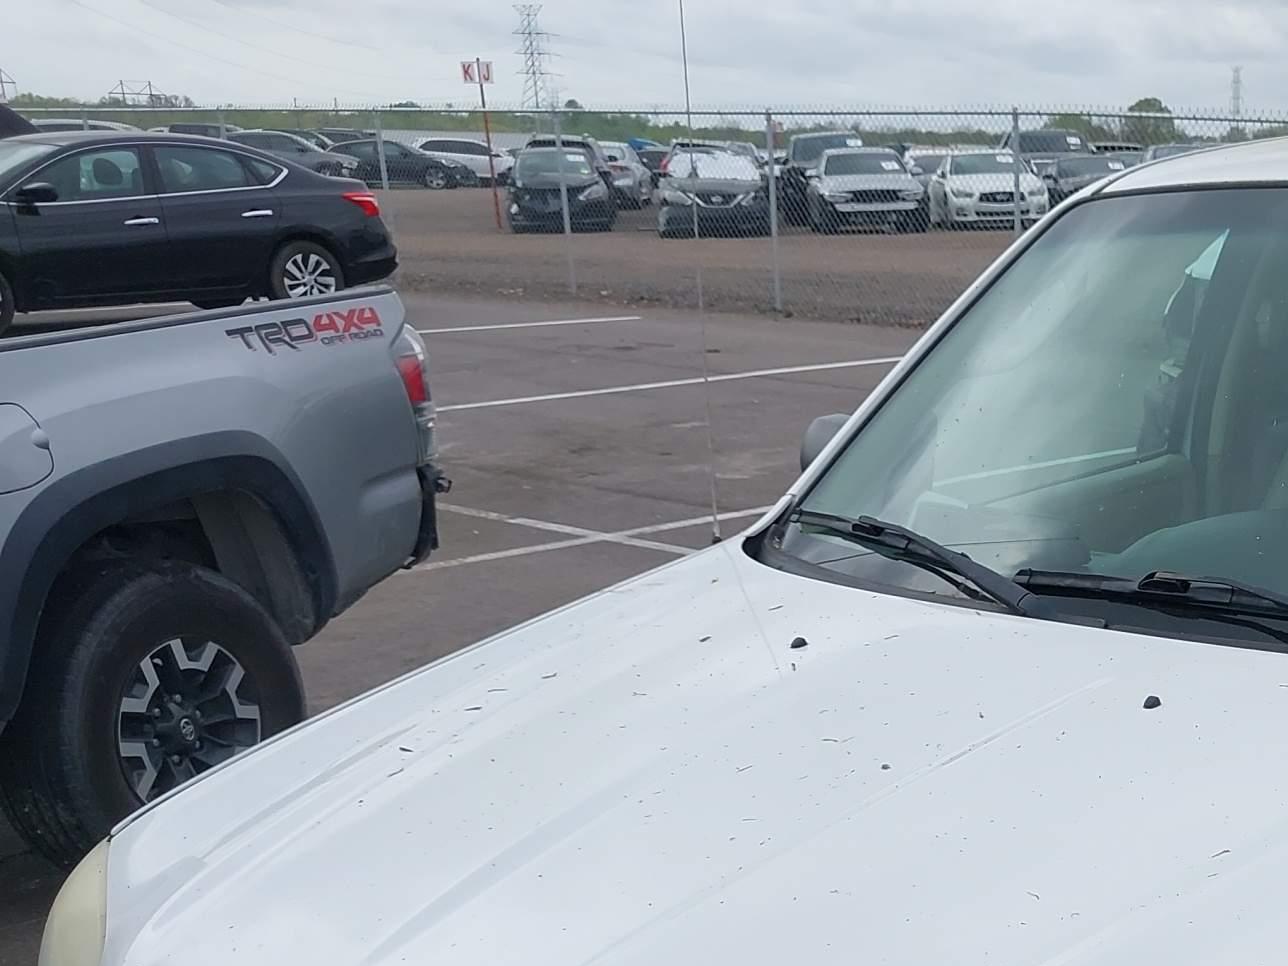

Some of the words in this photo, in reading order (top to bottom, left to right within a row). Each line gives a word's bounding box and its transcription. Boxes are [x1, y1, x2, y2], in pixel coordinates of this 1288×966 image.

[462, 63, 473, 81] K
[482, 63, 490, 81] J
[225, 318, 316, 356] TRD
[320, 334, 347, 346] OFF
[349, 328, 385, 342] ROAD
